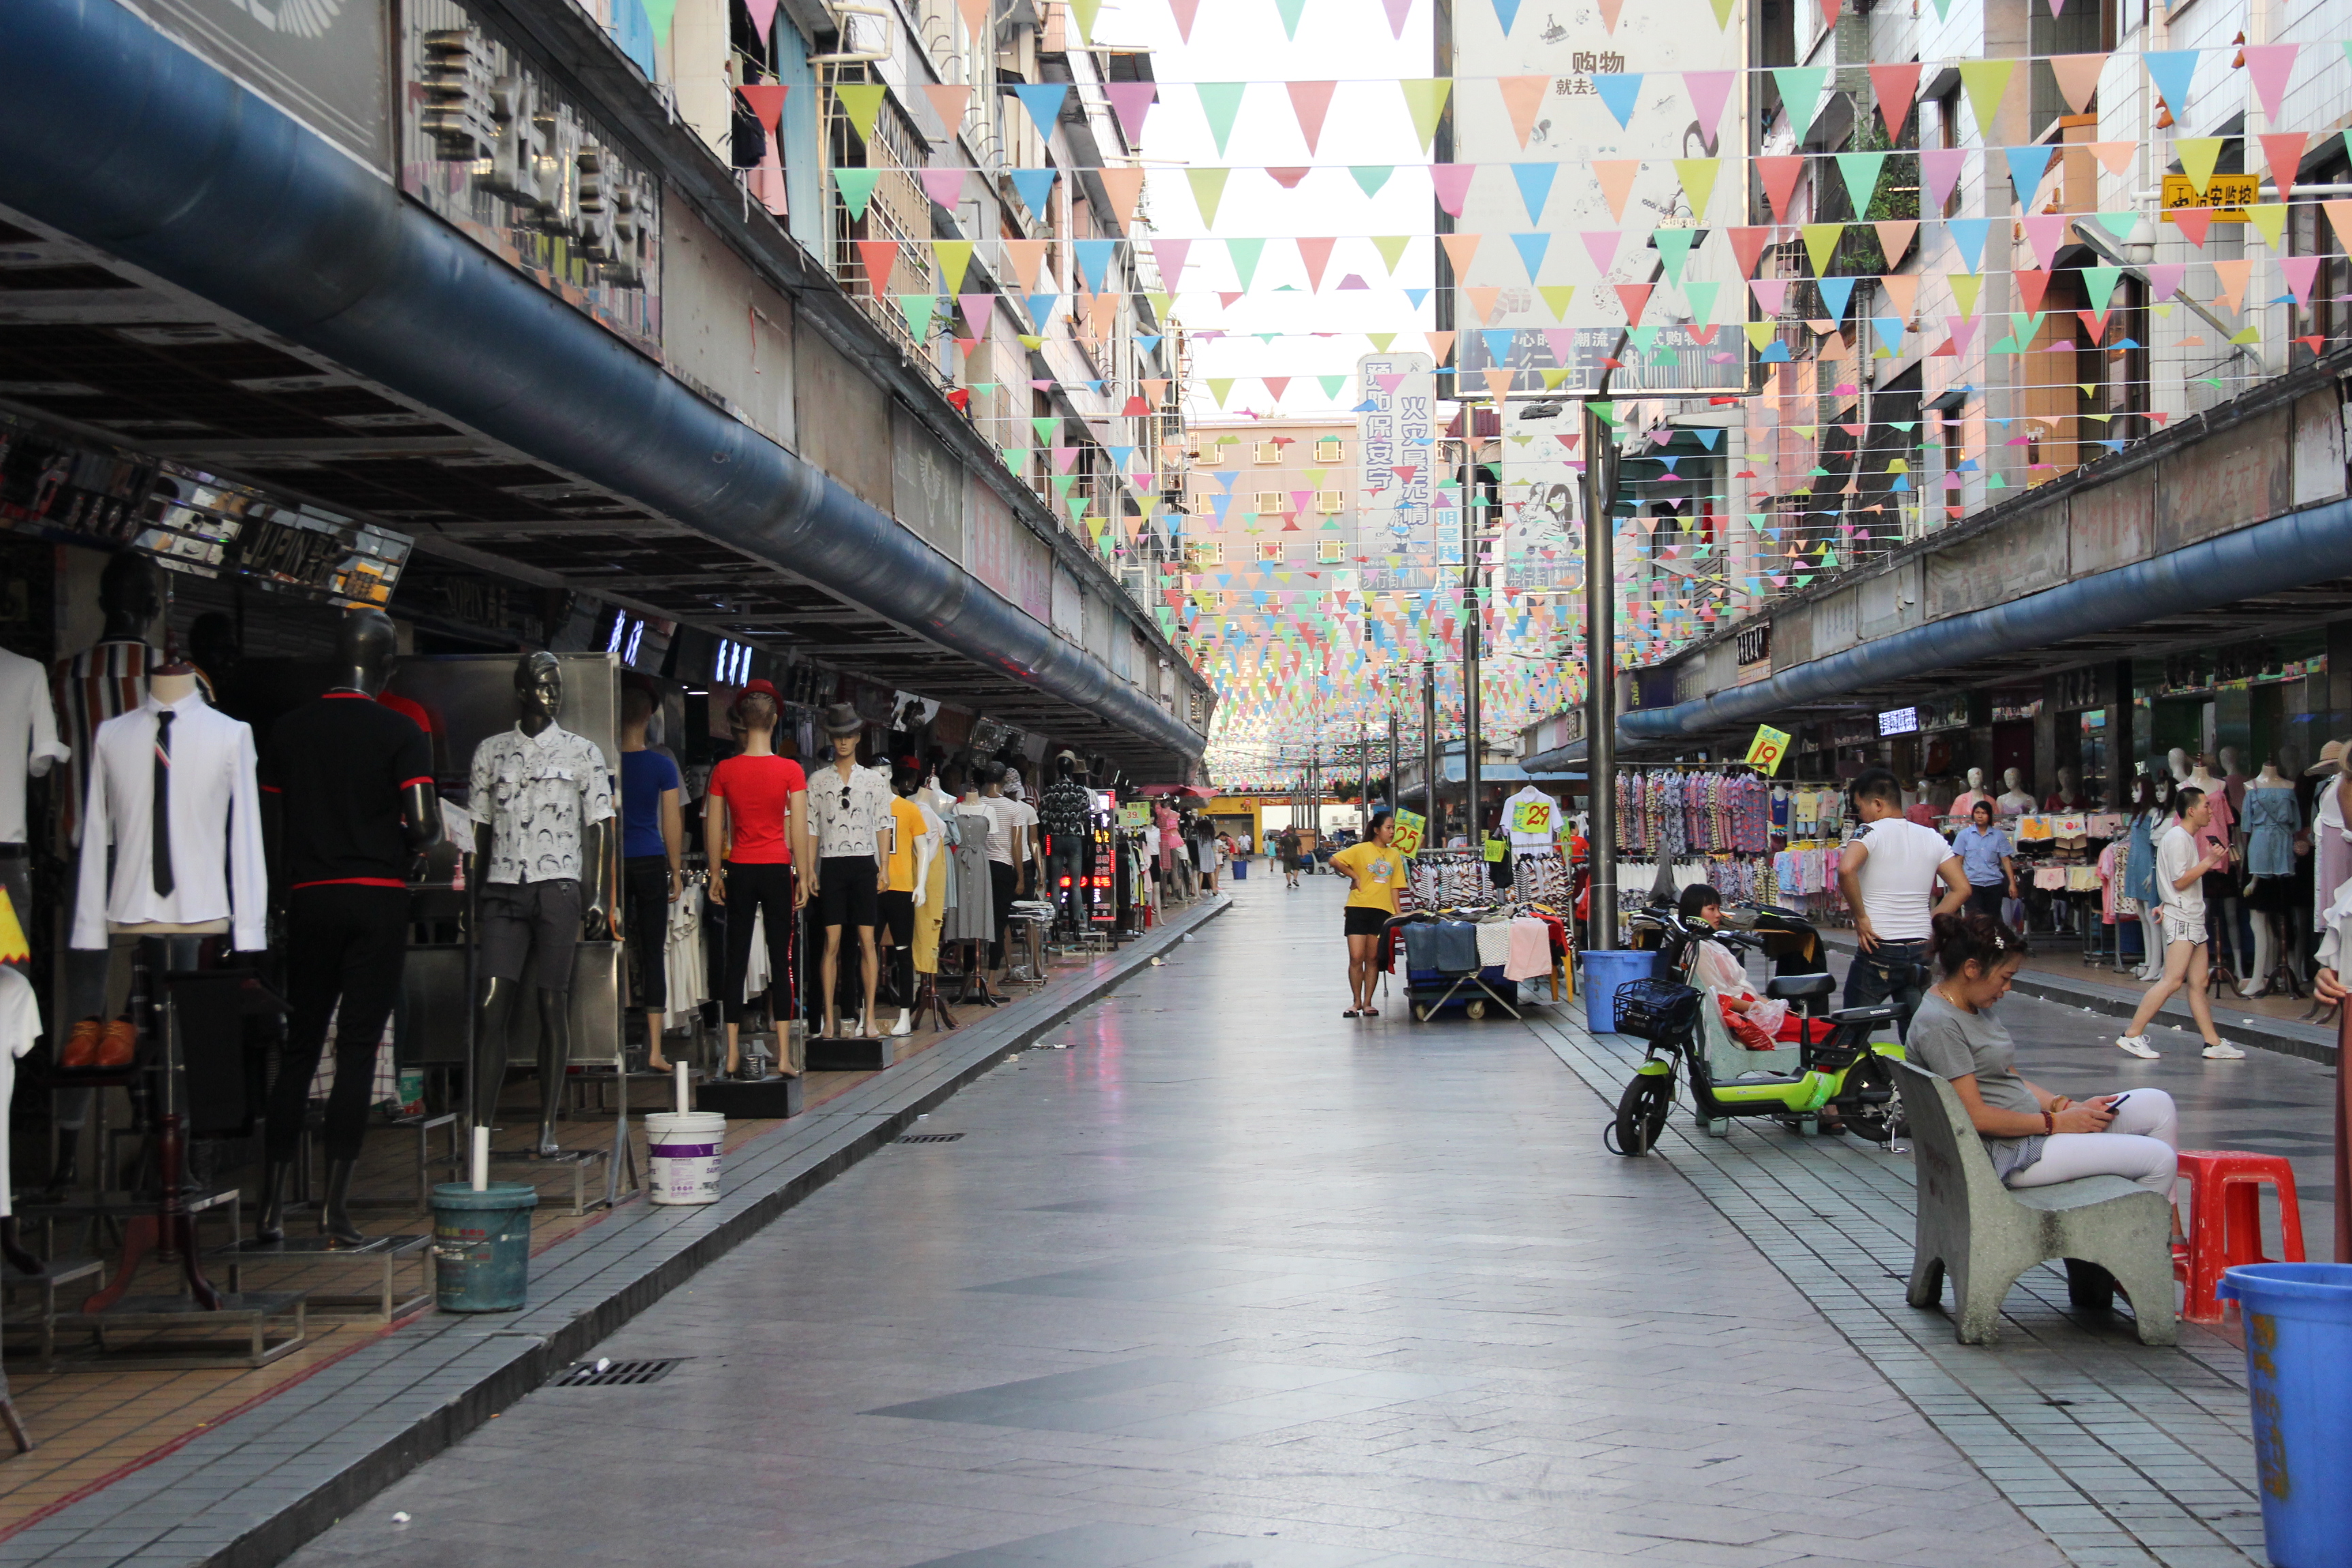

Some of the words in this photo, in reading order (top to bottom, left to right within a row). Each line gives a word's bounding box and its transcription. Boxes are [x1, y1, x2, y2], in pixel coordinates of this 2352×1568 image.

[1573, 51, 1624, 74] 购物
[1366, 363, 1392, 489] 预防保安宁
[1401, 396, 1428, 525] 火灾最无情
[1750, 741, 1777, 770] 19
[1526, 805, 1550, 826] 29
[1390, 826, 1418, 853] 25
